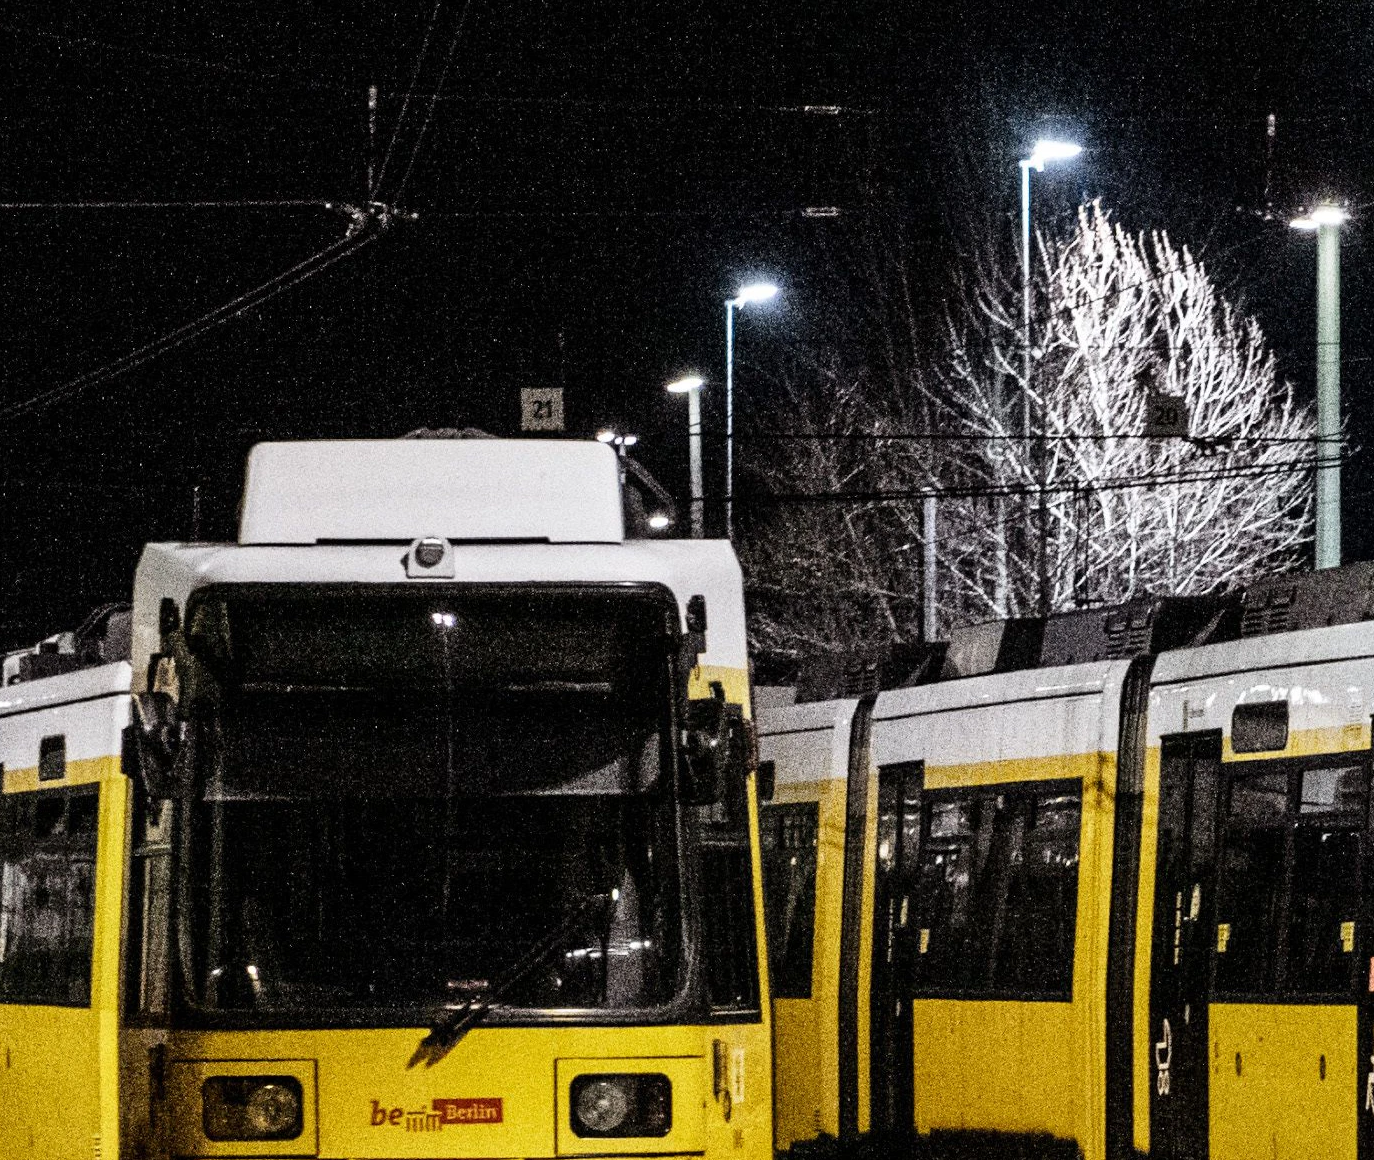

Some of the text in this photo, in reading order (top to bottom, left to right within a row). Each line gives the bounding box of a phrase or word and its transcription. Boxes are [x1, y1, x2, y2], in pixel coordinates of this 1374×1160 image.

[532, 400, 553, 419] 21
[1155, 406, 1179, 426] 20
[369, 1099, 498, 1126] be Berlin
